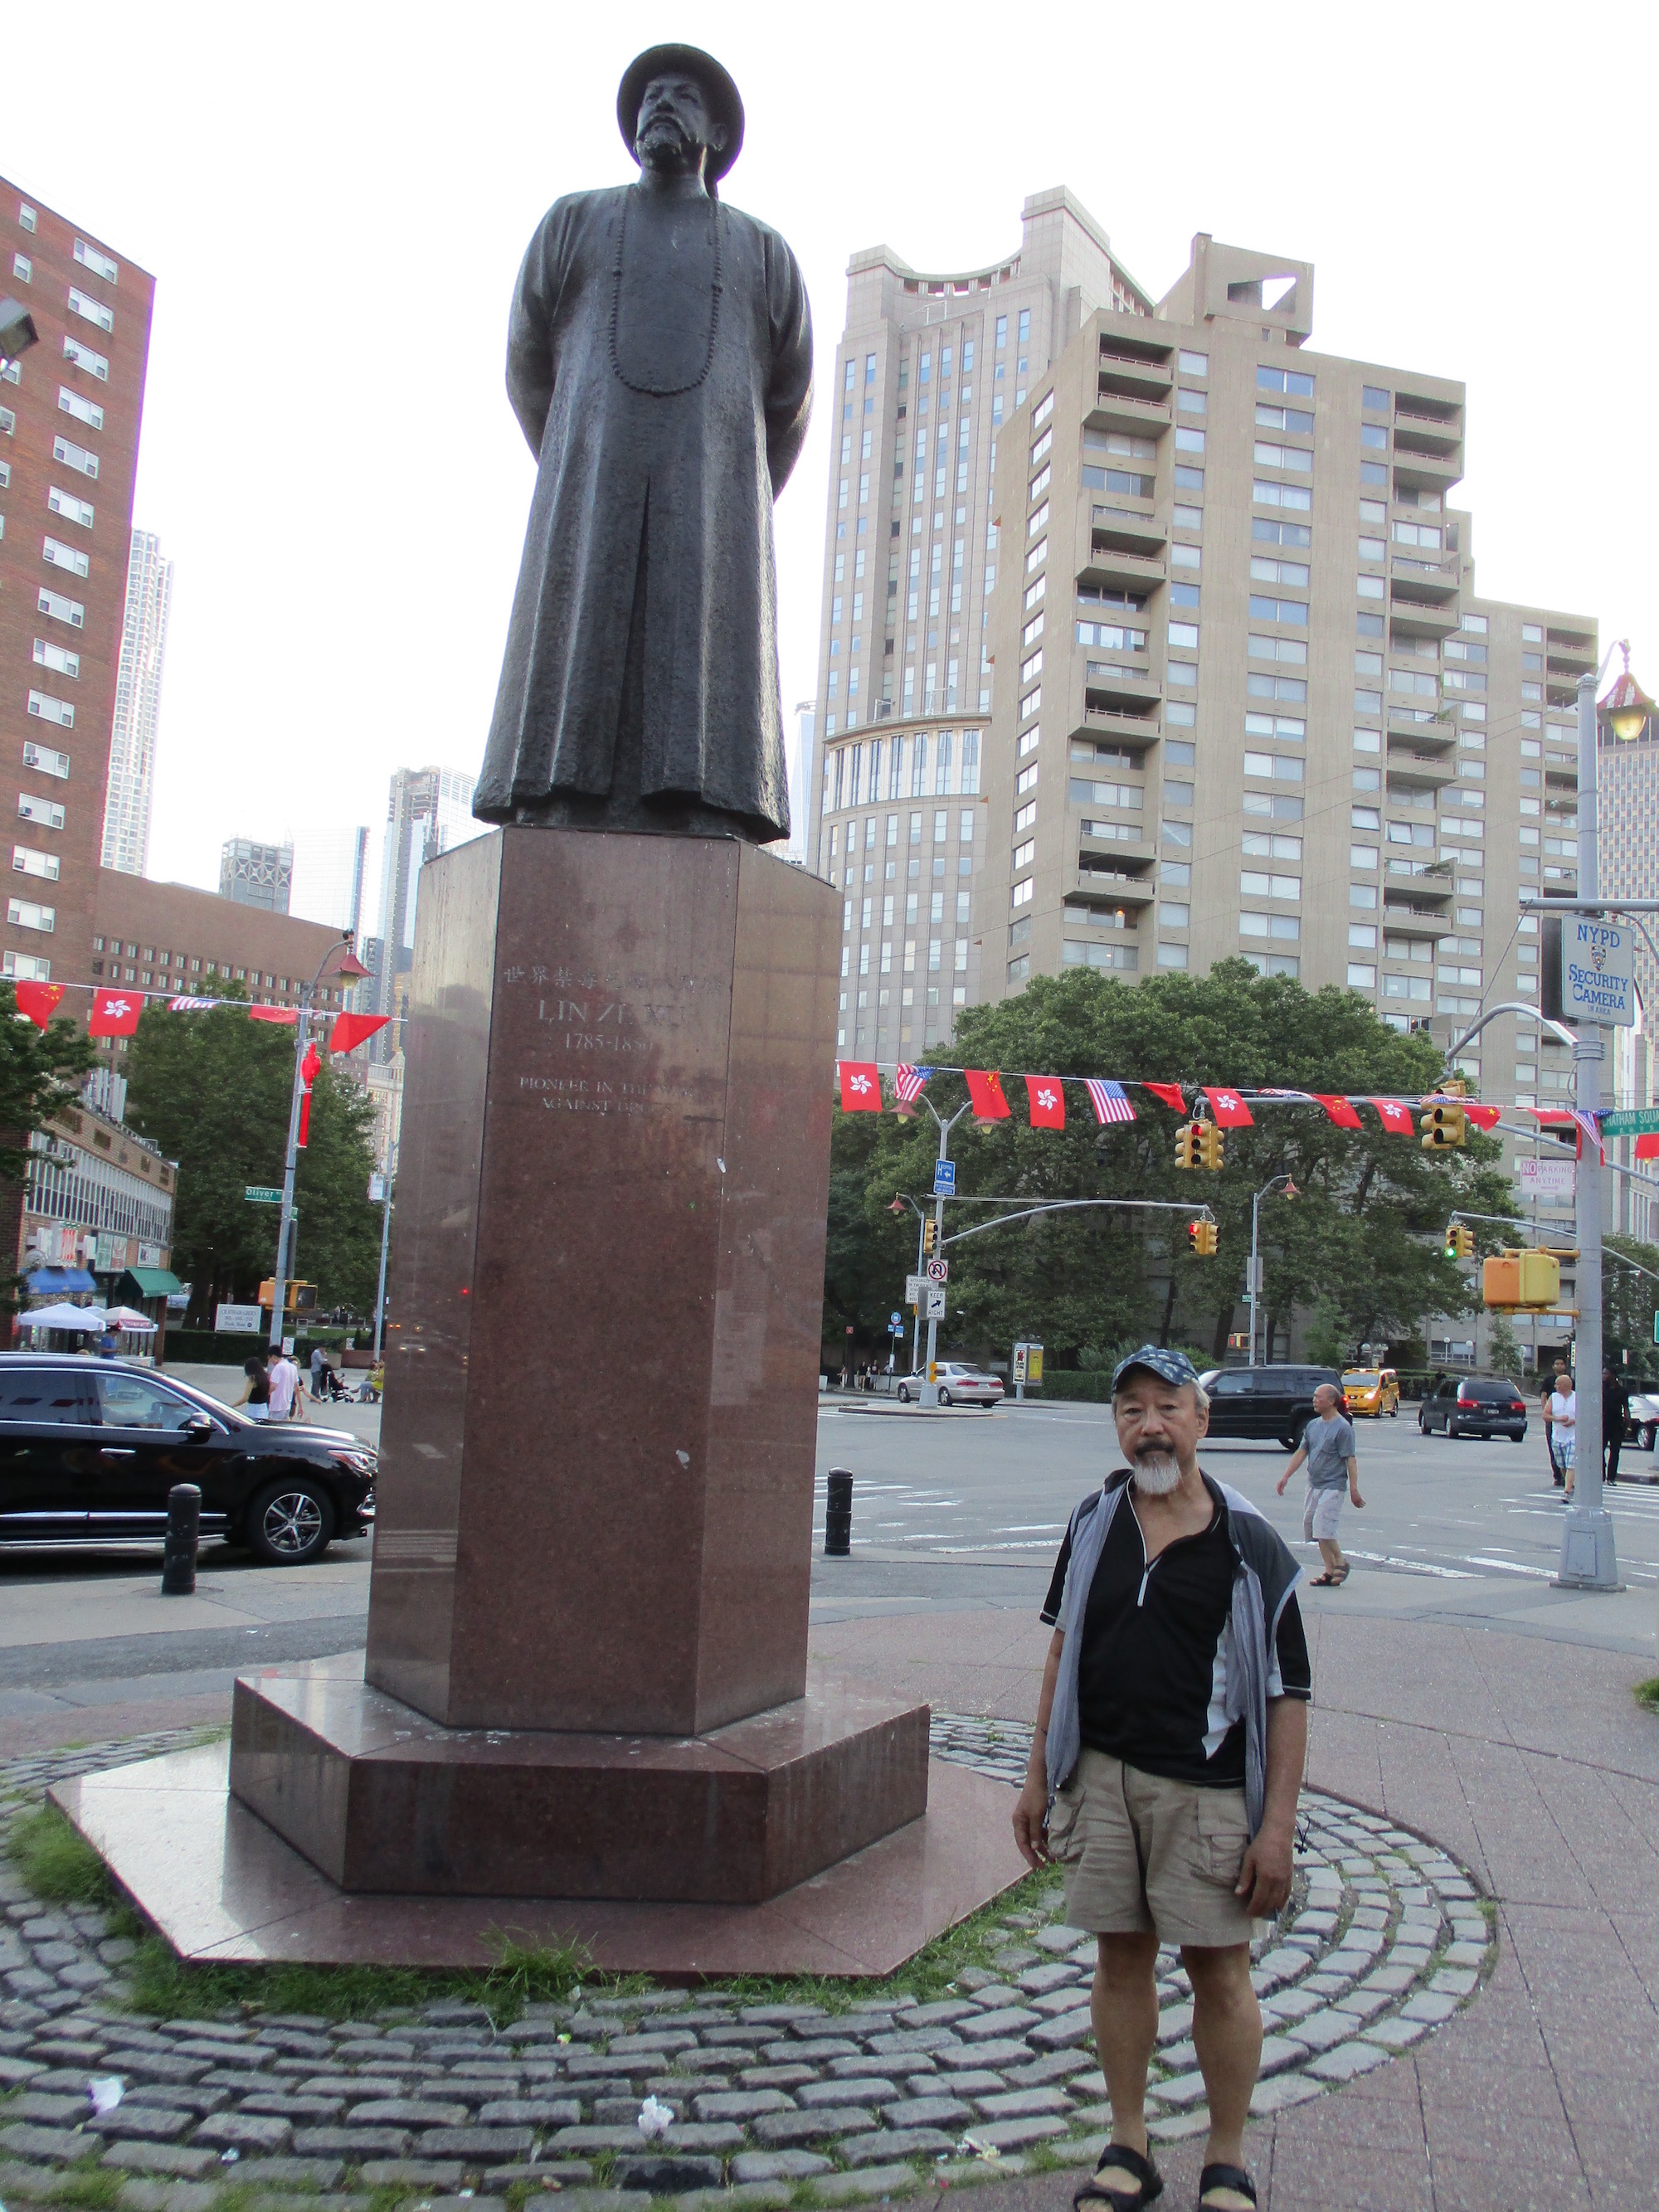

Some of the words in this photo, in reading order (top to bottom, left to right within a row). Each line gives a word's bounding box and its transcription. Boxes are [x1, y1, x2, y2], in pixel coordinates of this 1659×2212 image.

[1577, 924, 1620, 947] NYPD
[1569, 964, 1628, 992] SECURITY
[1573, 984, 1625, 1009] CAMERA
[538, 999, 587, 1023] LIN
[519, 1077, 588, 1093] PIONEER
[596, 1082, 613, 1094] IN
[542, 1097, 611, 1112] AGAINST
[1522, 1162, 1536, 1174] NO
[1538, 1166, 1572, 1174] PARKING
[1530, 1177, 1565, 1185] ANYTIME
[246, 1189, 274, 1198] Oliver
